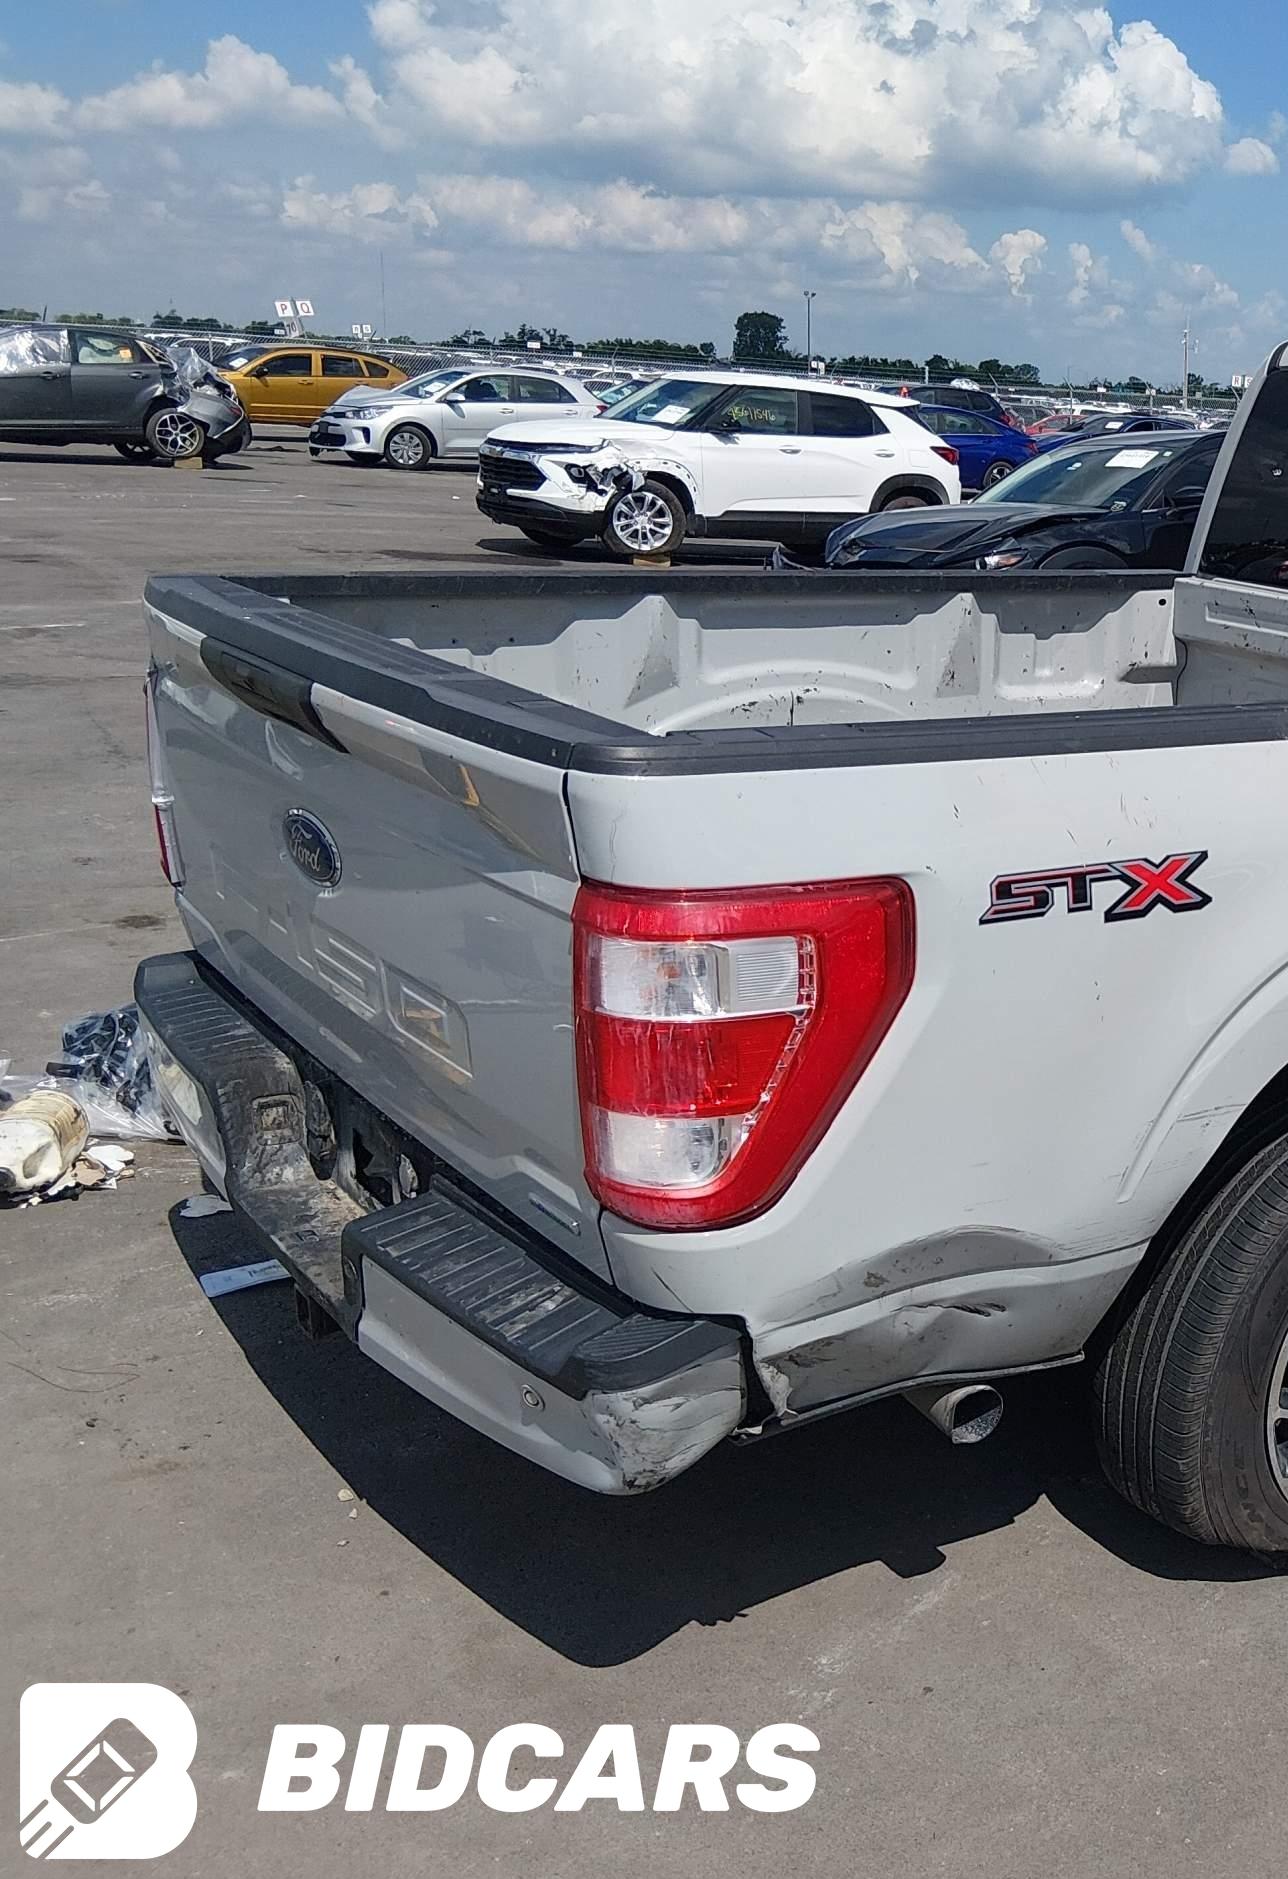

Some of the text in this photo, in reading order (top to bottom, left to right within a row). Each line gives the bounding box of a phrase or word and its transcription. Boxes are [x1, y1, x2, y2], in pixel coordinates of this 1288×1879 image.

[279, 303, 288, 315] P
[299, 302, 312, 314] Q
[289, 823, 321, 872] Ford
[979, 850, 1213, 926] STX
